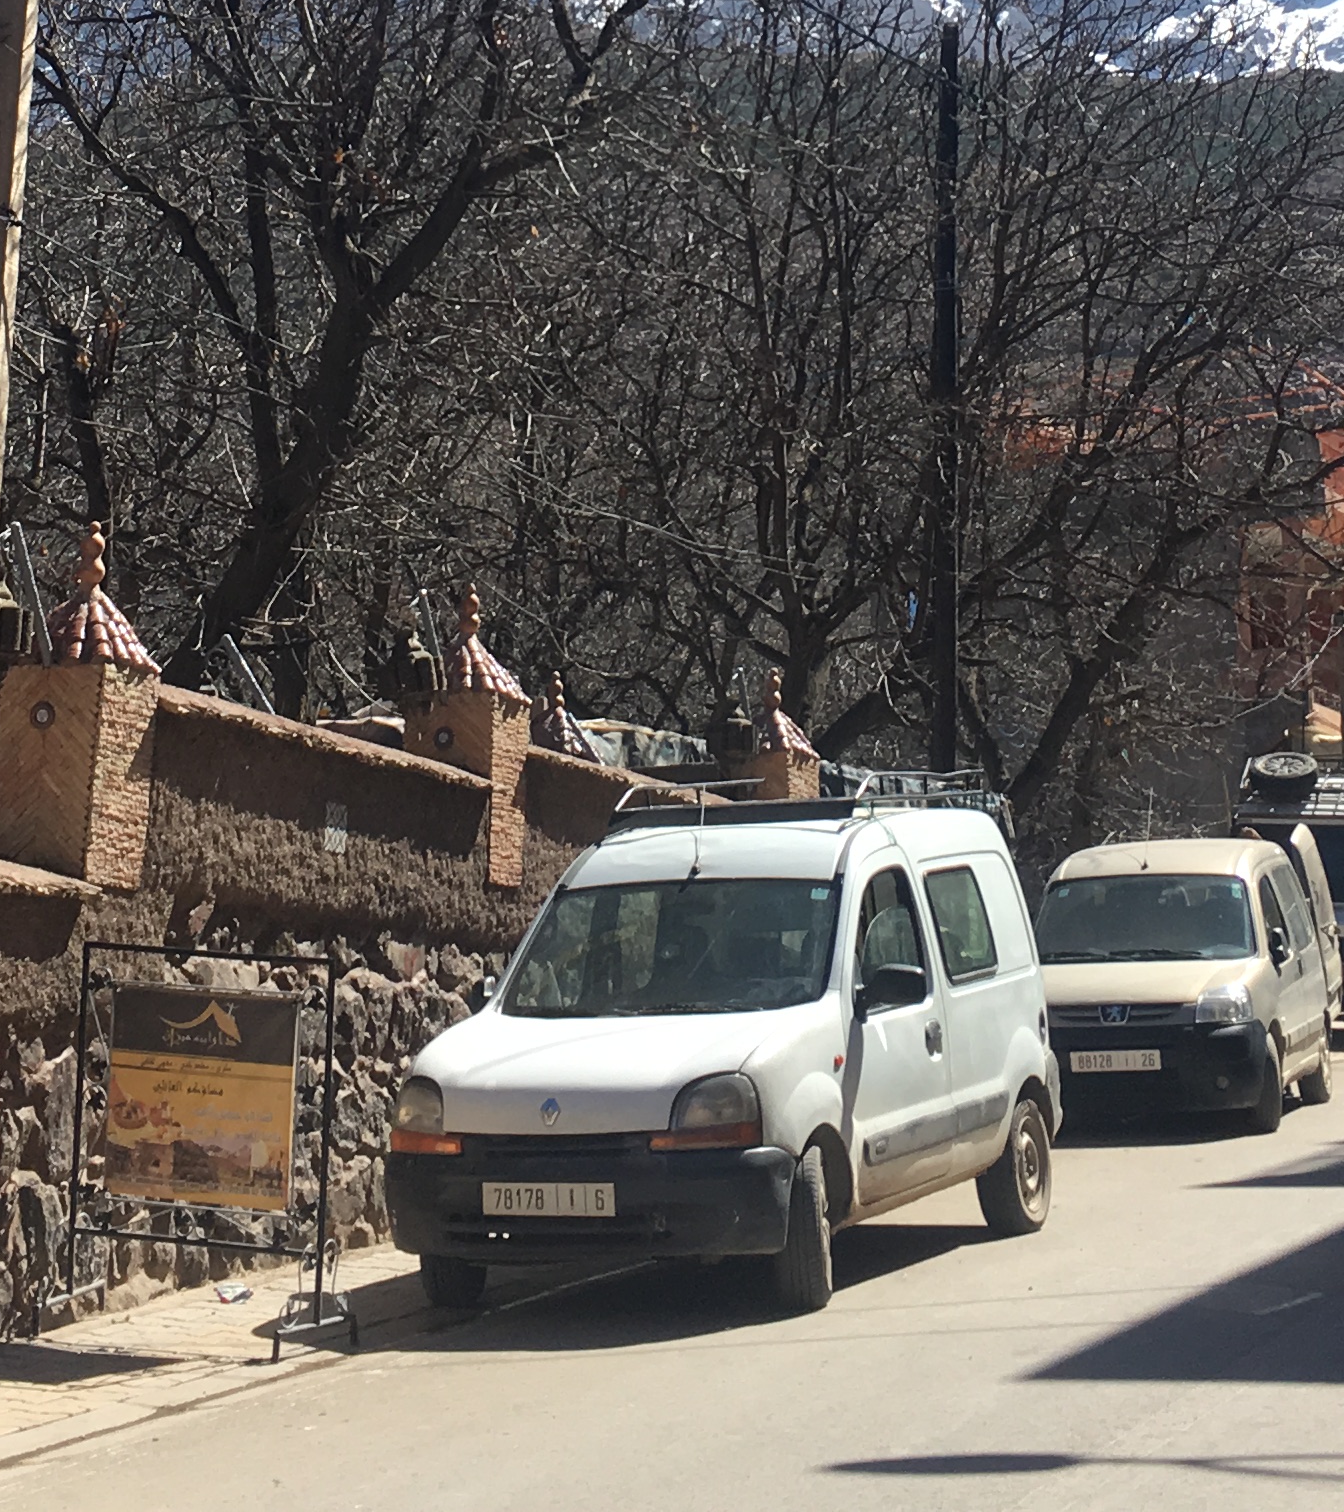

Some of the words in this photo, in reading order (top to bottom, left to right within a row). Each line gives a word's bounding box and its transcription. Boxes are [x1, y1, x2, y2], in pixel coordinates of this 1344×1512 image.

[1141, 1053, 1156, 1067] 26
[494, 1188, 544, 1210] 78178
[595, 1189, 605, 1210] 6
